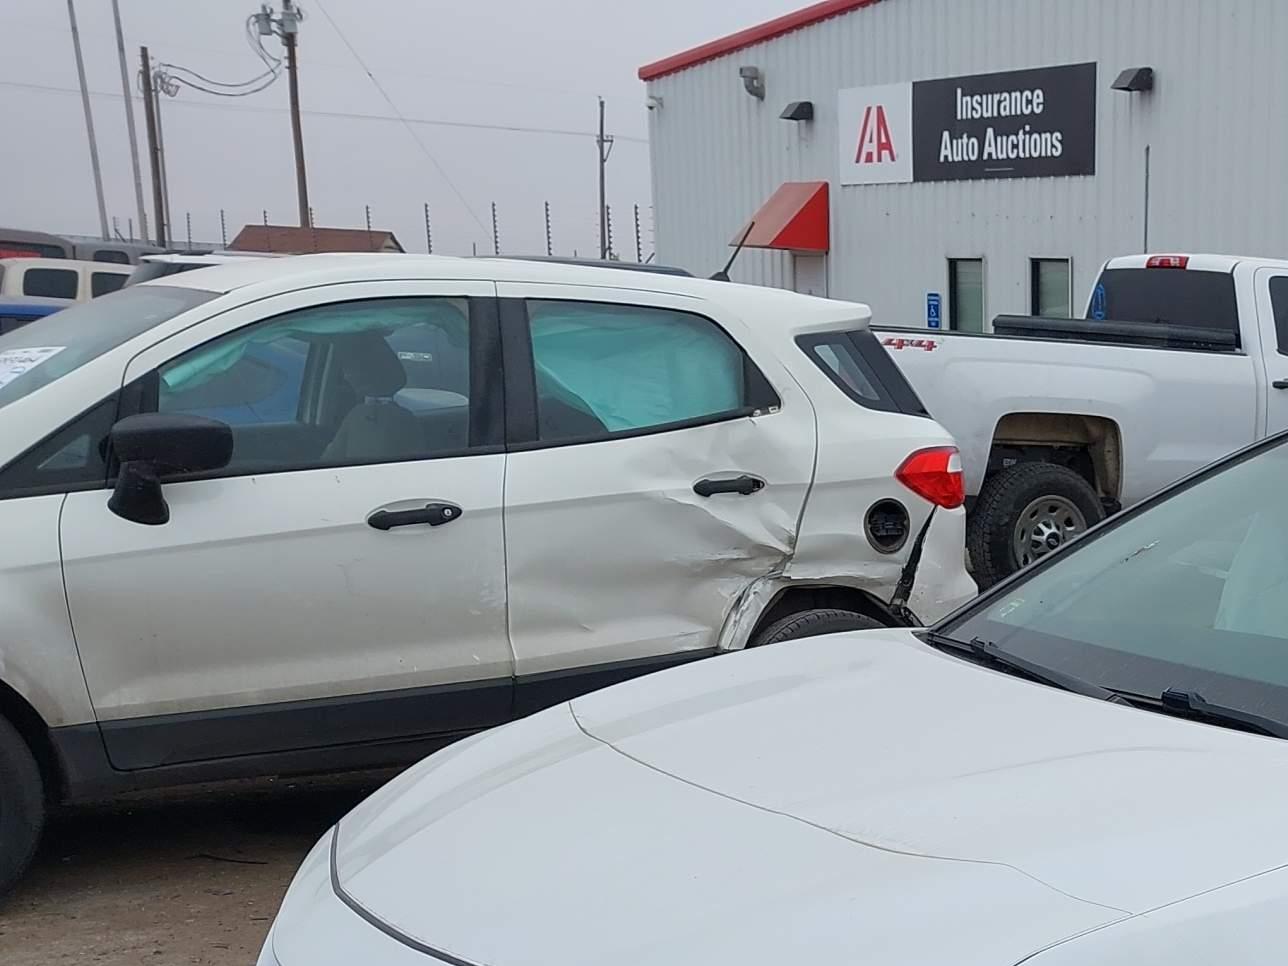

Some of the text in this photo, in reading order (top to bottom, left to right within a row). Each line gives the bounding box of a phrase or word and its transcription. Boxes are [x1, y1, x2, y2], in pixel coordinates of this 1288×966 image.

[956, 87, 1045, 121] Insurance
[939, 125, 1064, 164] Auto Auctions
